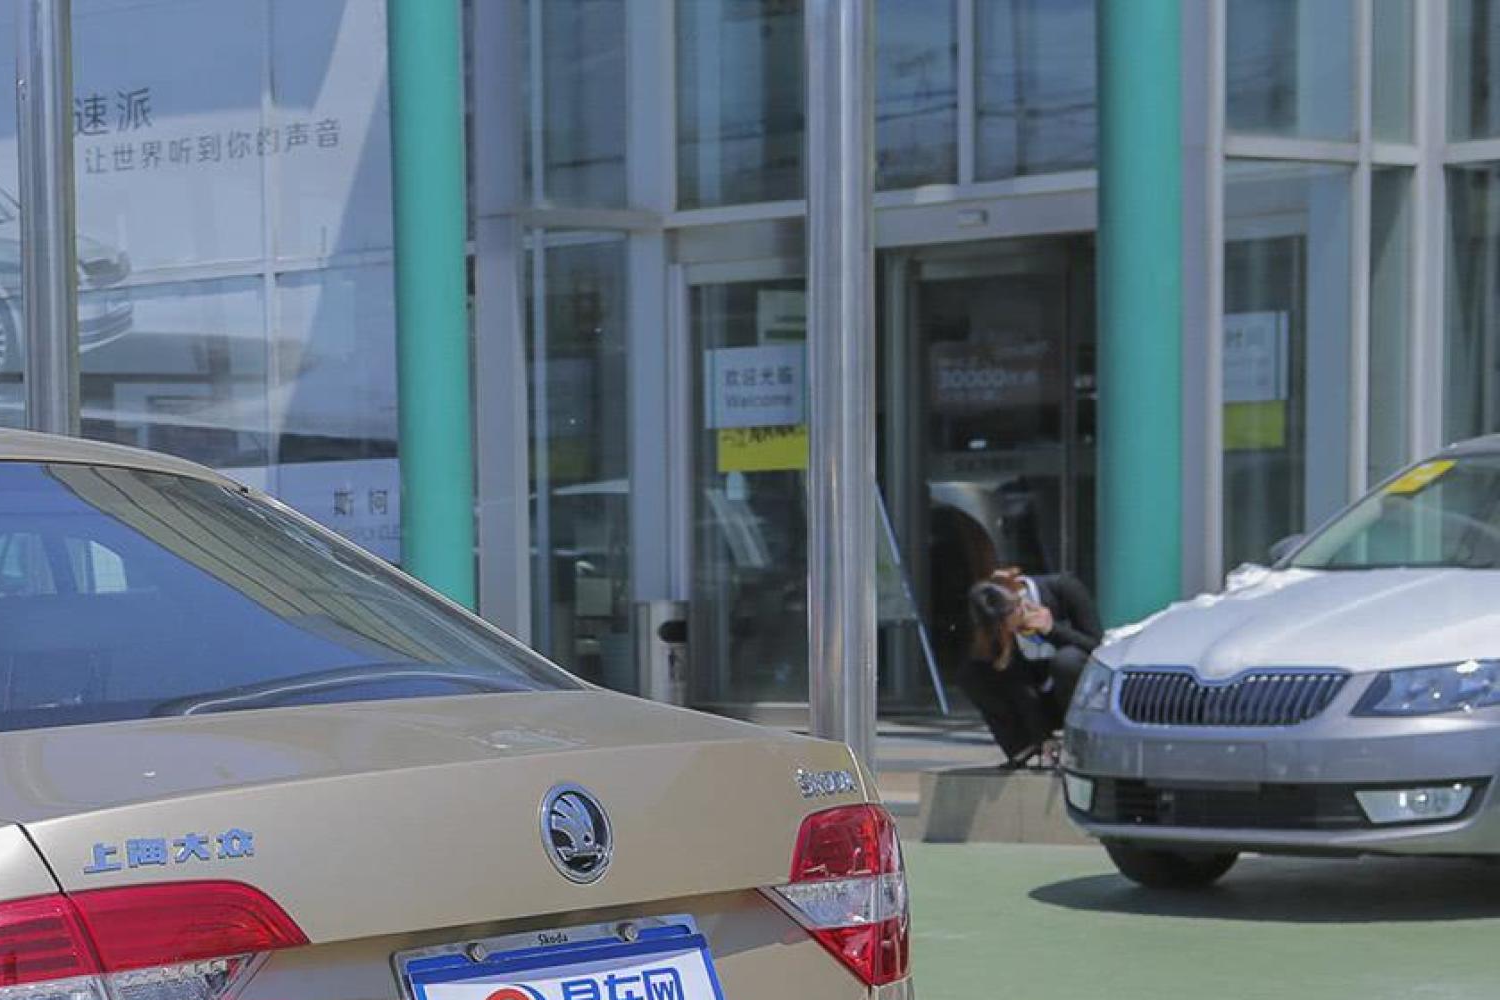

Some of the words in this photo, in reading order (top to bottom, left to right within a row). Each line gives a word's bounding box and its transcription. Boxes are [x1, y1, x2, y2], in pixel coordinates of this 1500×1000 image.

[74, 88, 152, 137] 速派
[85, 118, 341, 175] 让世界听到你的声音
[83, 827, 255, 875] 上海大众
